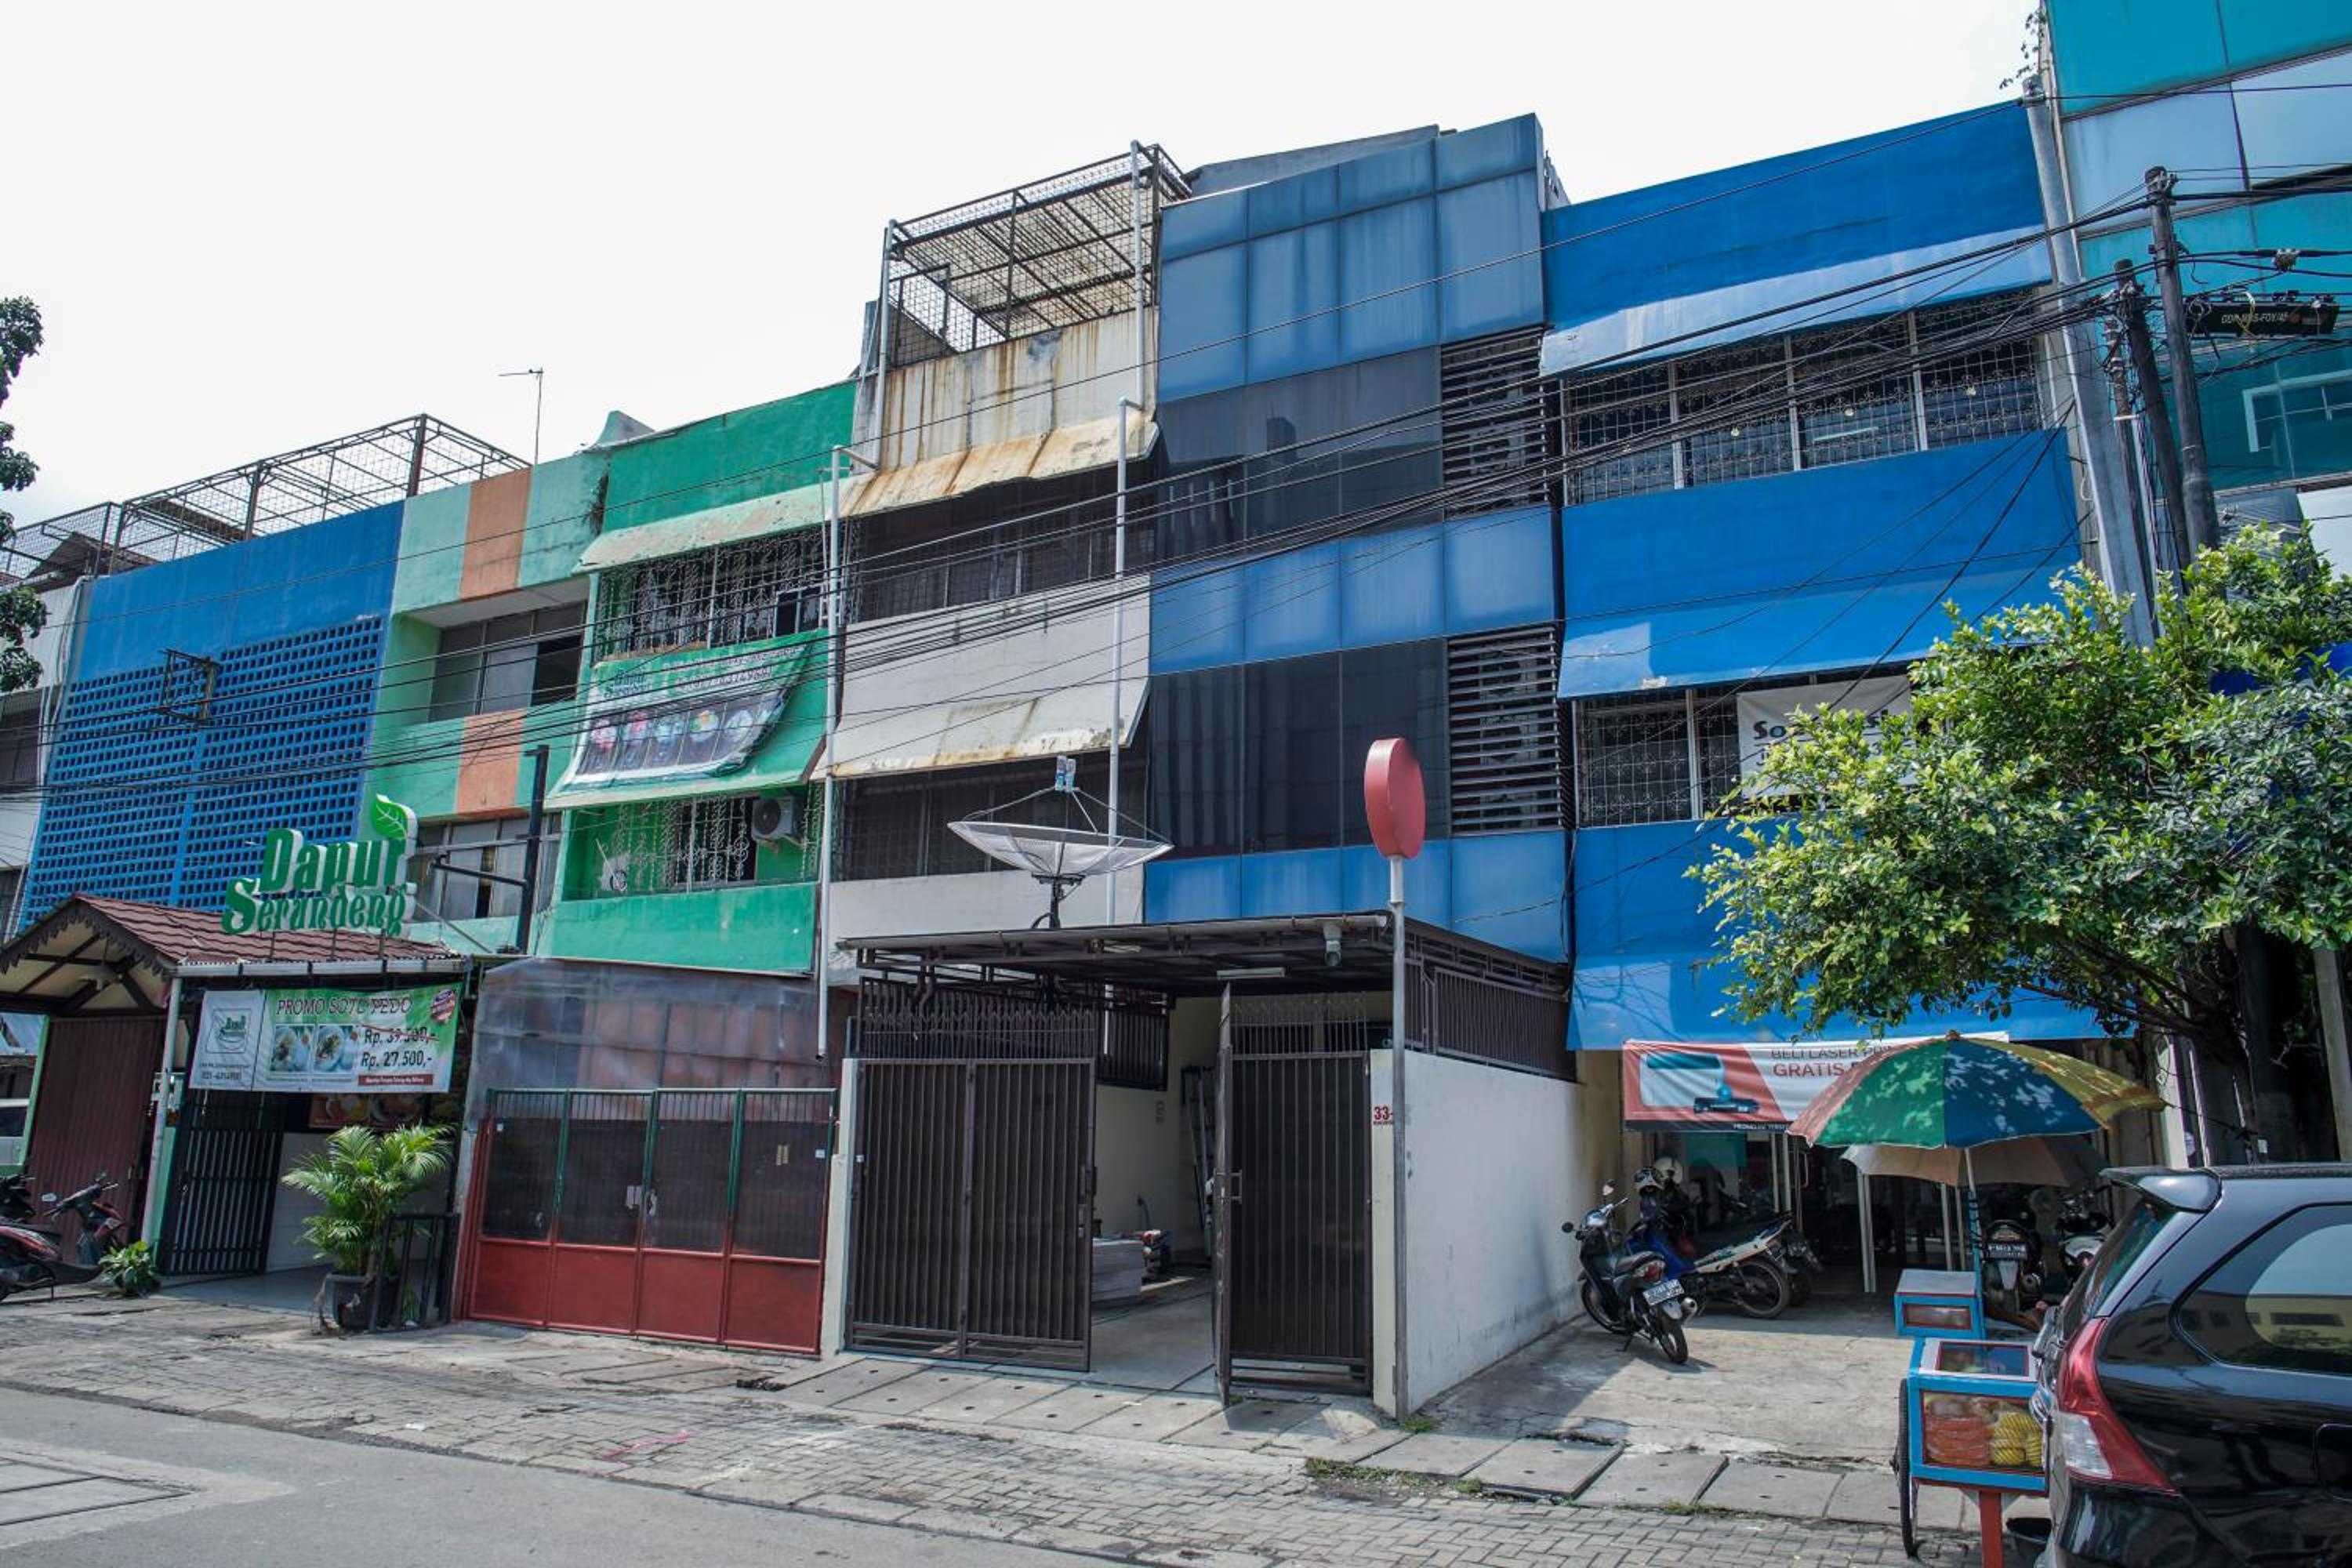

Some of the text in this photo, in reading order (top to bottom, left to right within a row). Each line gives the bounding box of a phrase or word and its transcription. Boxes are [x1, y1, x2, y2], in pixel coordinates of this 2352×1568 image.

[259, 827, 408, 895] Dapur
[221, 877, 408, 937] Serundeng
[276, 998, 327, 1015] PROMO
[361, 1051, 380, 1071] Rp.
[1809, 1047, 1859, 1058] LASER
[1773, 1062, 1846, 1077] GRATIS
